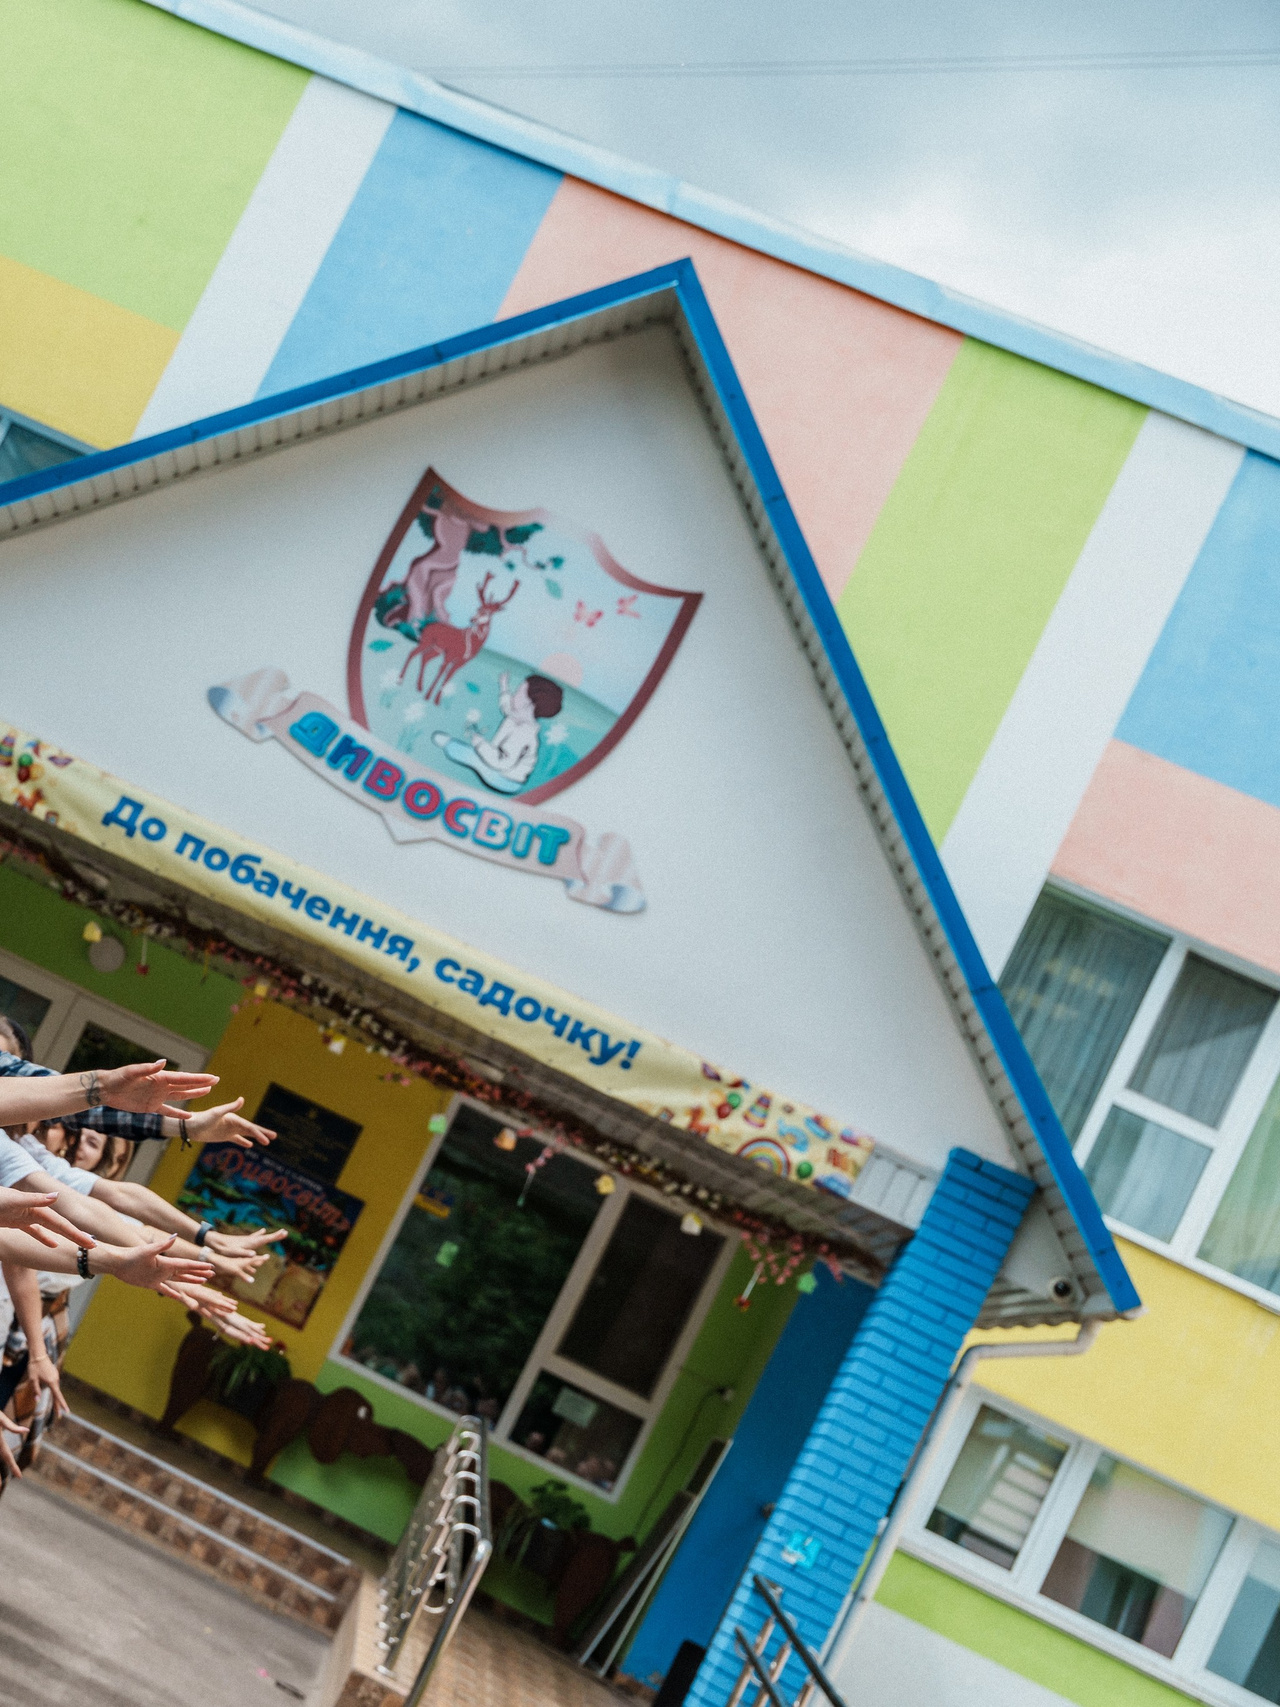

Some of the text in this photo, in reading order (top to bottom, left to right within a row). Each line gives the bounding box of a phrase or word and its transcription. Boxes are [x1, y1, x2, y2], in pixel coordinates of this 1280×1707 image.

[288, 711, 571, 866] ДИВОСВІТ
[102, 796, 642, 1070] До побачення, садочку!
